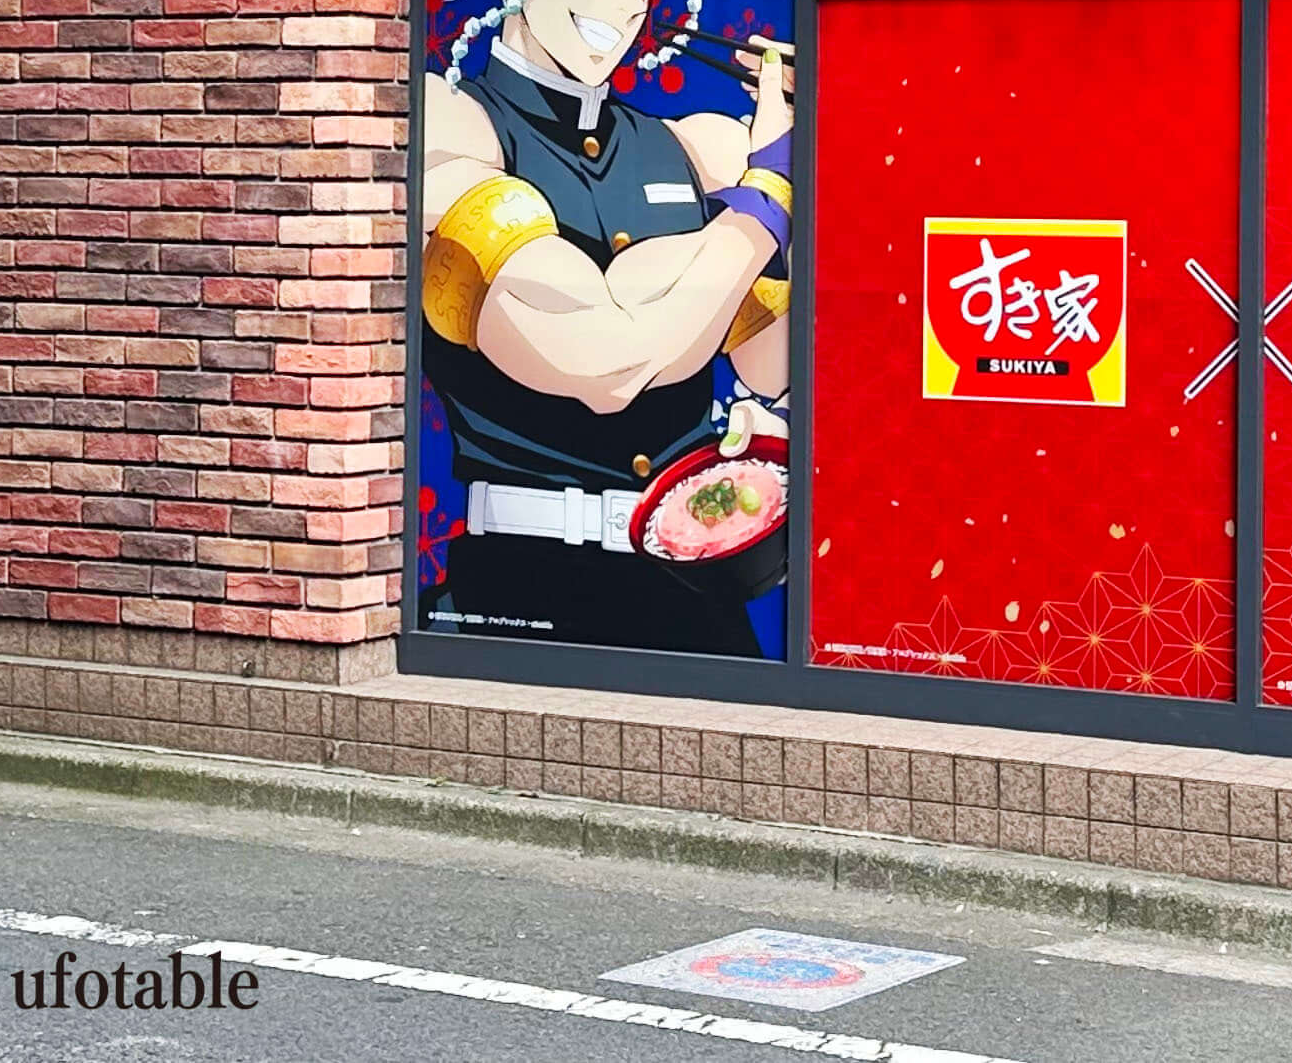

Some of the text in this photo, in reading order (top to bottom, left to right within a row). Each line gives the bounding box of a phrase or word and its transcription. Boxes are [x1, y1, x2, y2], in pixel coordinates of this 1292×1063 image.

[949, 237, 1101, 356] すき家
[989, 359, 1057, 375] SUKIYA
